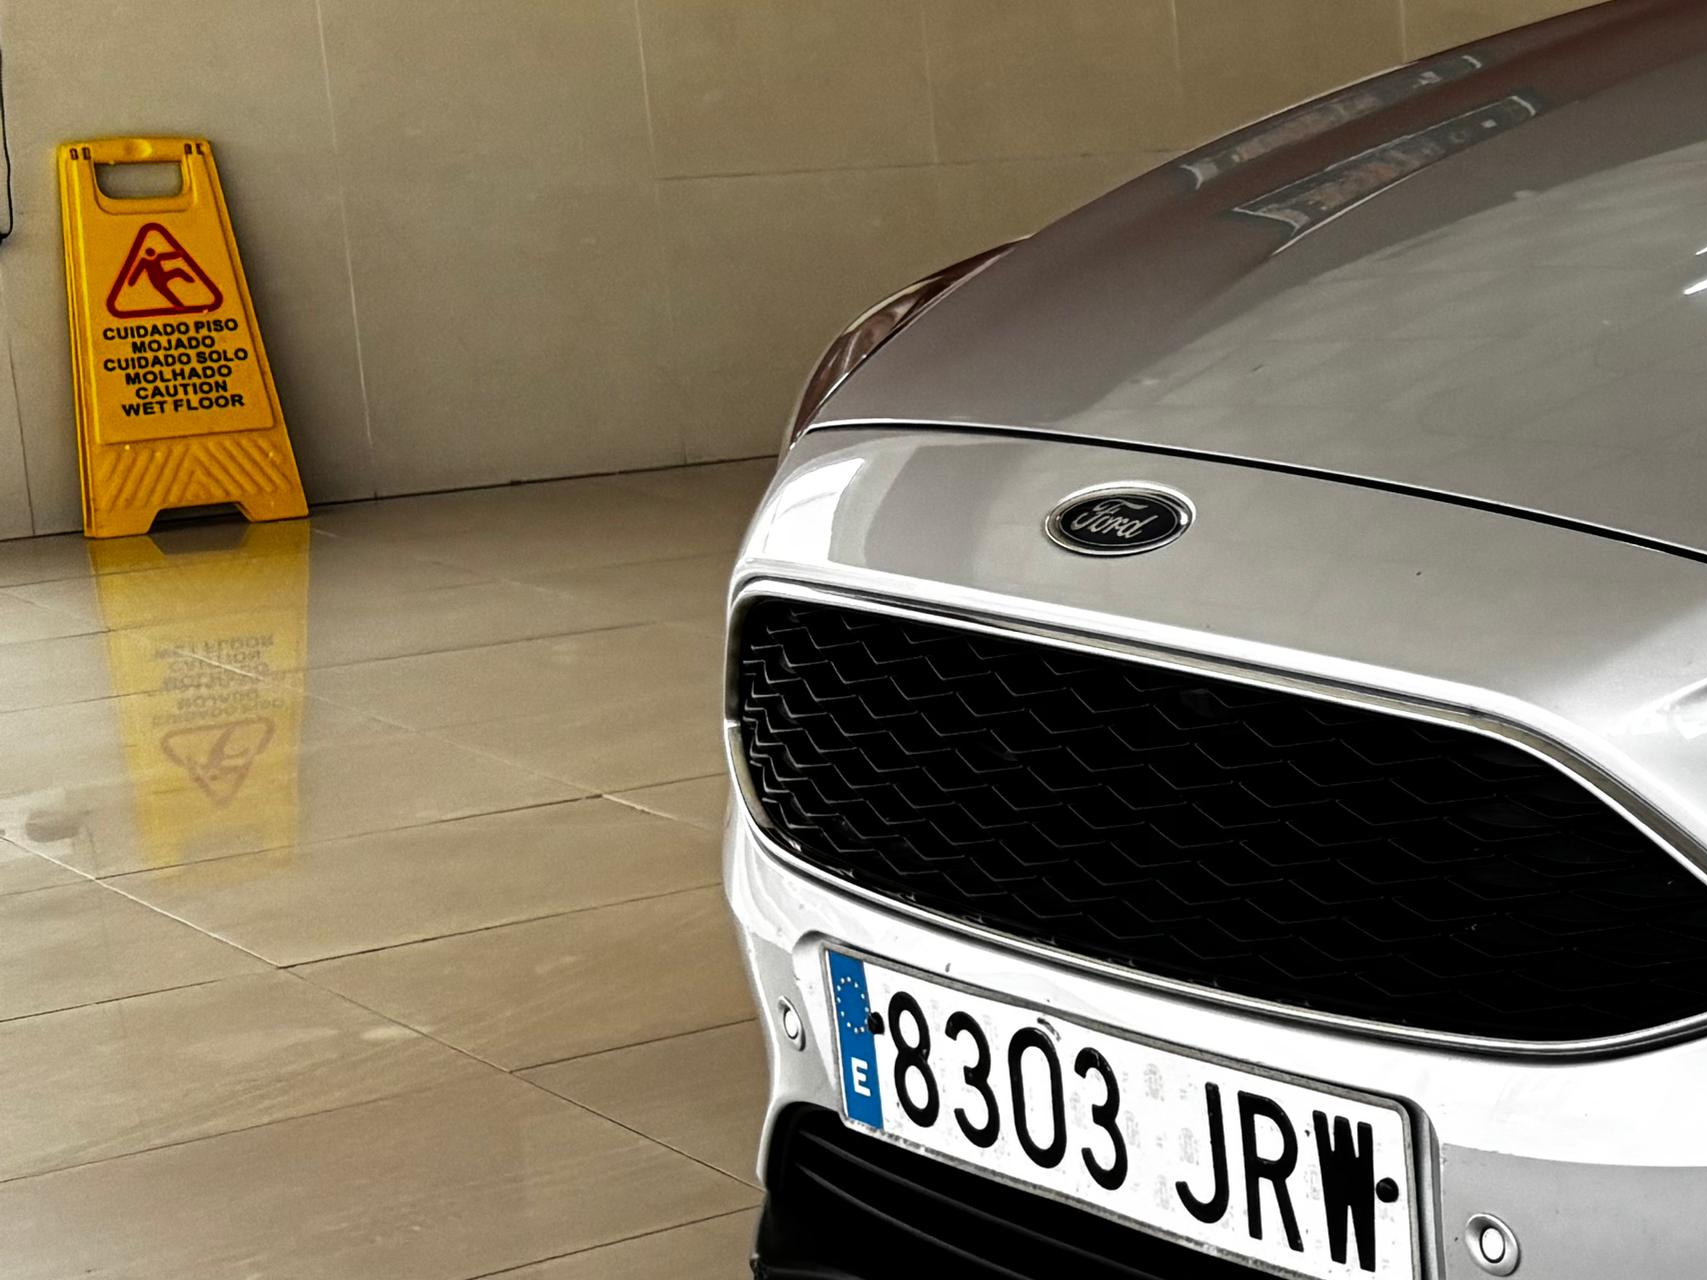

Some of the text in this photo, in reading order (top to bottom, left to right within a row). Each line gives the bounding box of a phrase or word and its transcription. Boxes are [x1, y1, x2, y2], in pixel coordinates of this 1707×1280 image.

[102, 318, 239, 341] CUIDADO PISO
[131, 335, 216, 355] MOJADO
[103, 347, 249, 372] CUIDADO SOLO
[124, 364, 233, 386] MOLHADO
[135, 379, 229, 400] CAUTION
[121, 393, 246, 417] WET FLOOR
[1069, 498, 1160, 539] Ford
[850, 1056, 872, 1098] E
[887, 989, 1377, 1274] 8303 JRW
